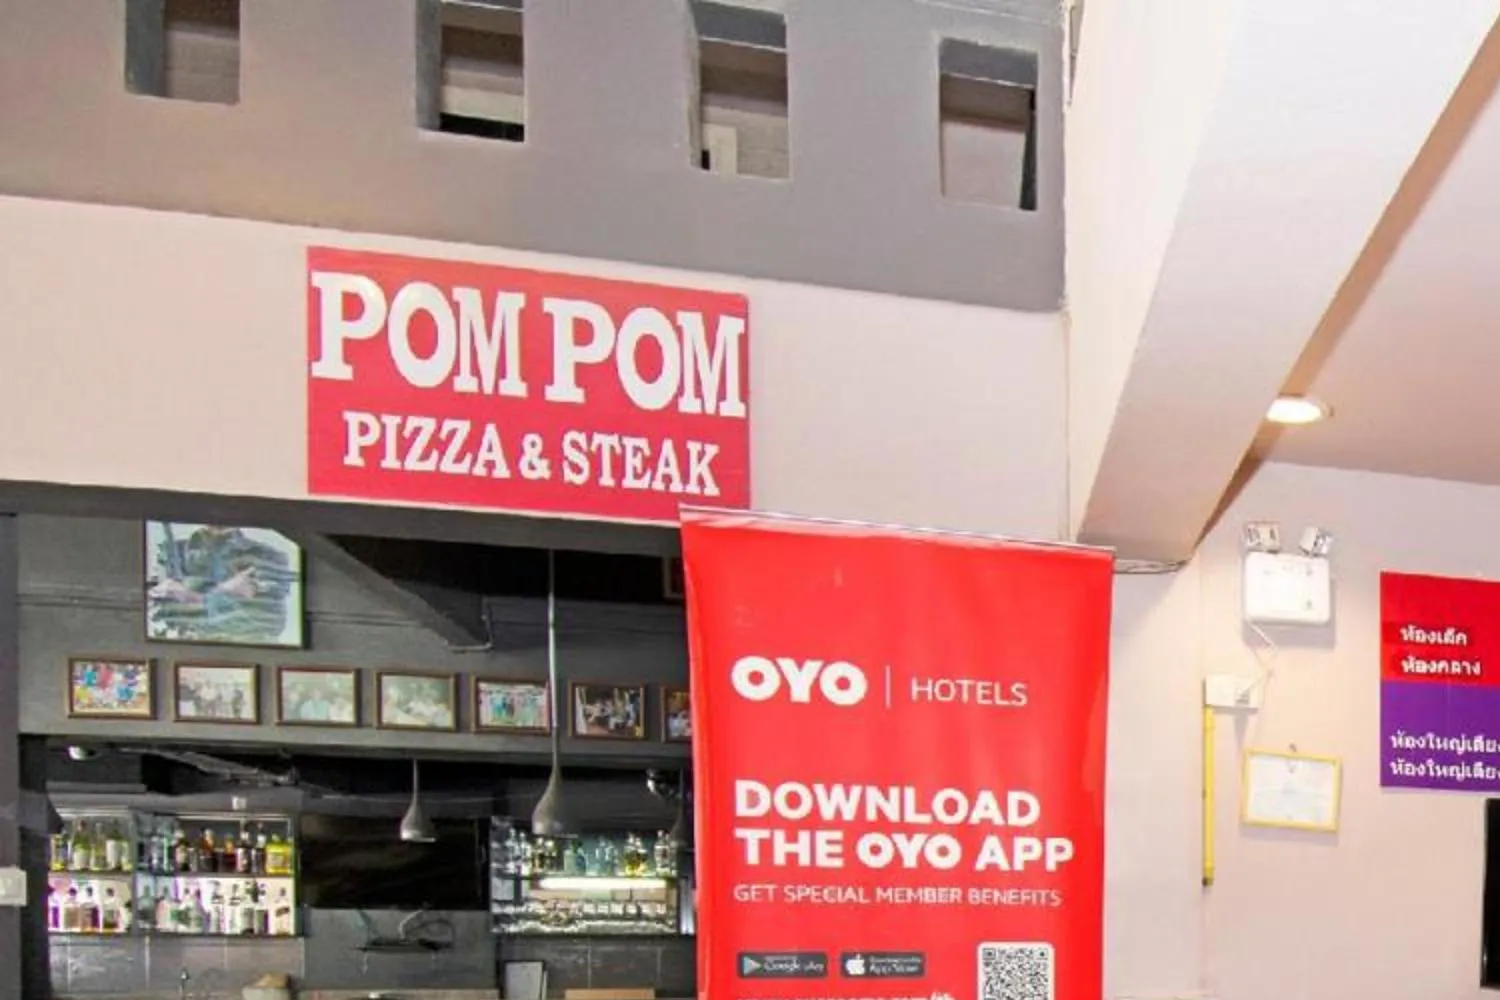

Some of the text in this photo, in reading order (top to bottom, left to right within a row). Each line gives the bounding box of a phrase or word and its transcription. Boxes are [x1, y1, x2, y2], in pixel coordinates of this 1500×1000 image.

[311, 271, 746, 418] POM POM
[343, 411, 720, 497] PIZZA & STEAK
[731, 655, 1029, 707] OYO HOTELS
[735, 779, 1041, 827] DOWNLOAD
[734, 827, 1074, 872] THE OYO APP
[733, 884, 1063, 907] GET SPECIAL MEMBER BENEFITS
